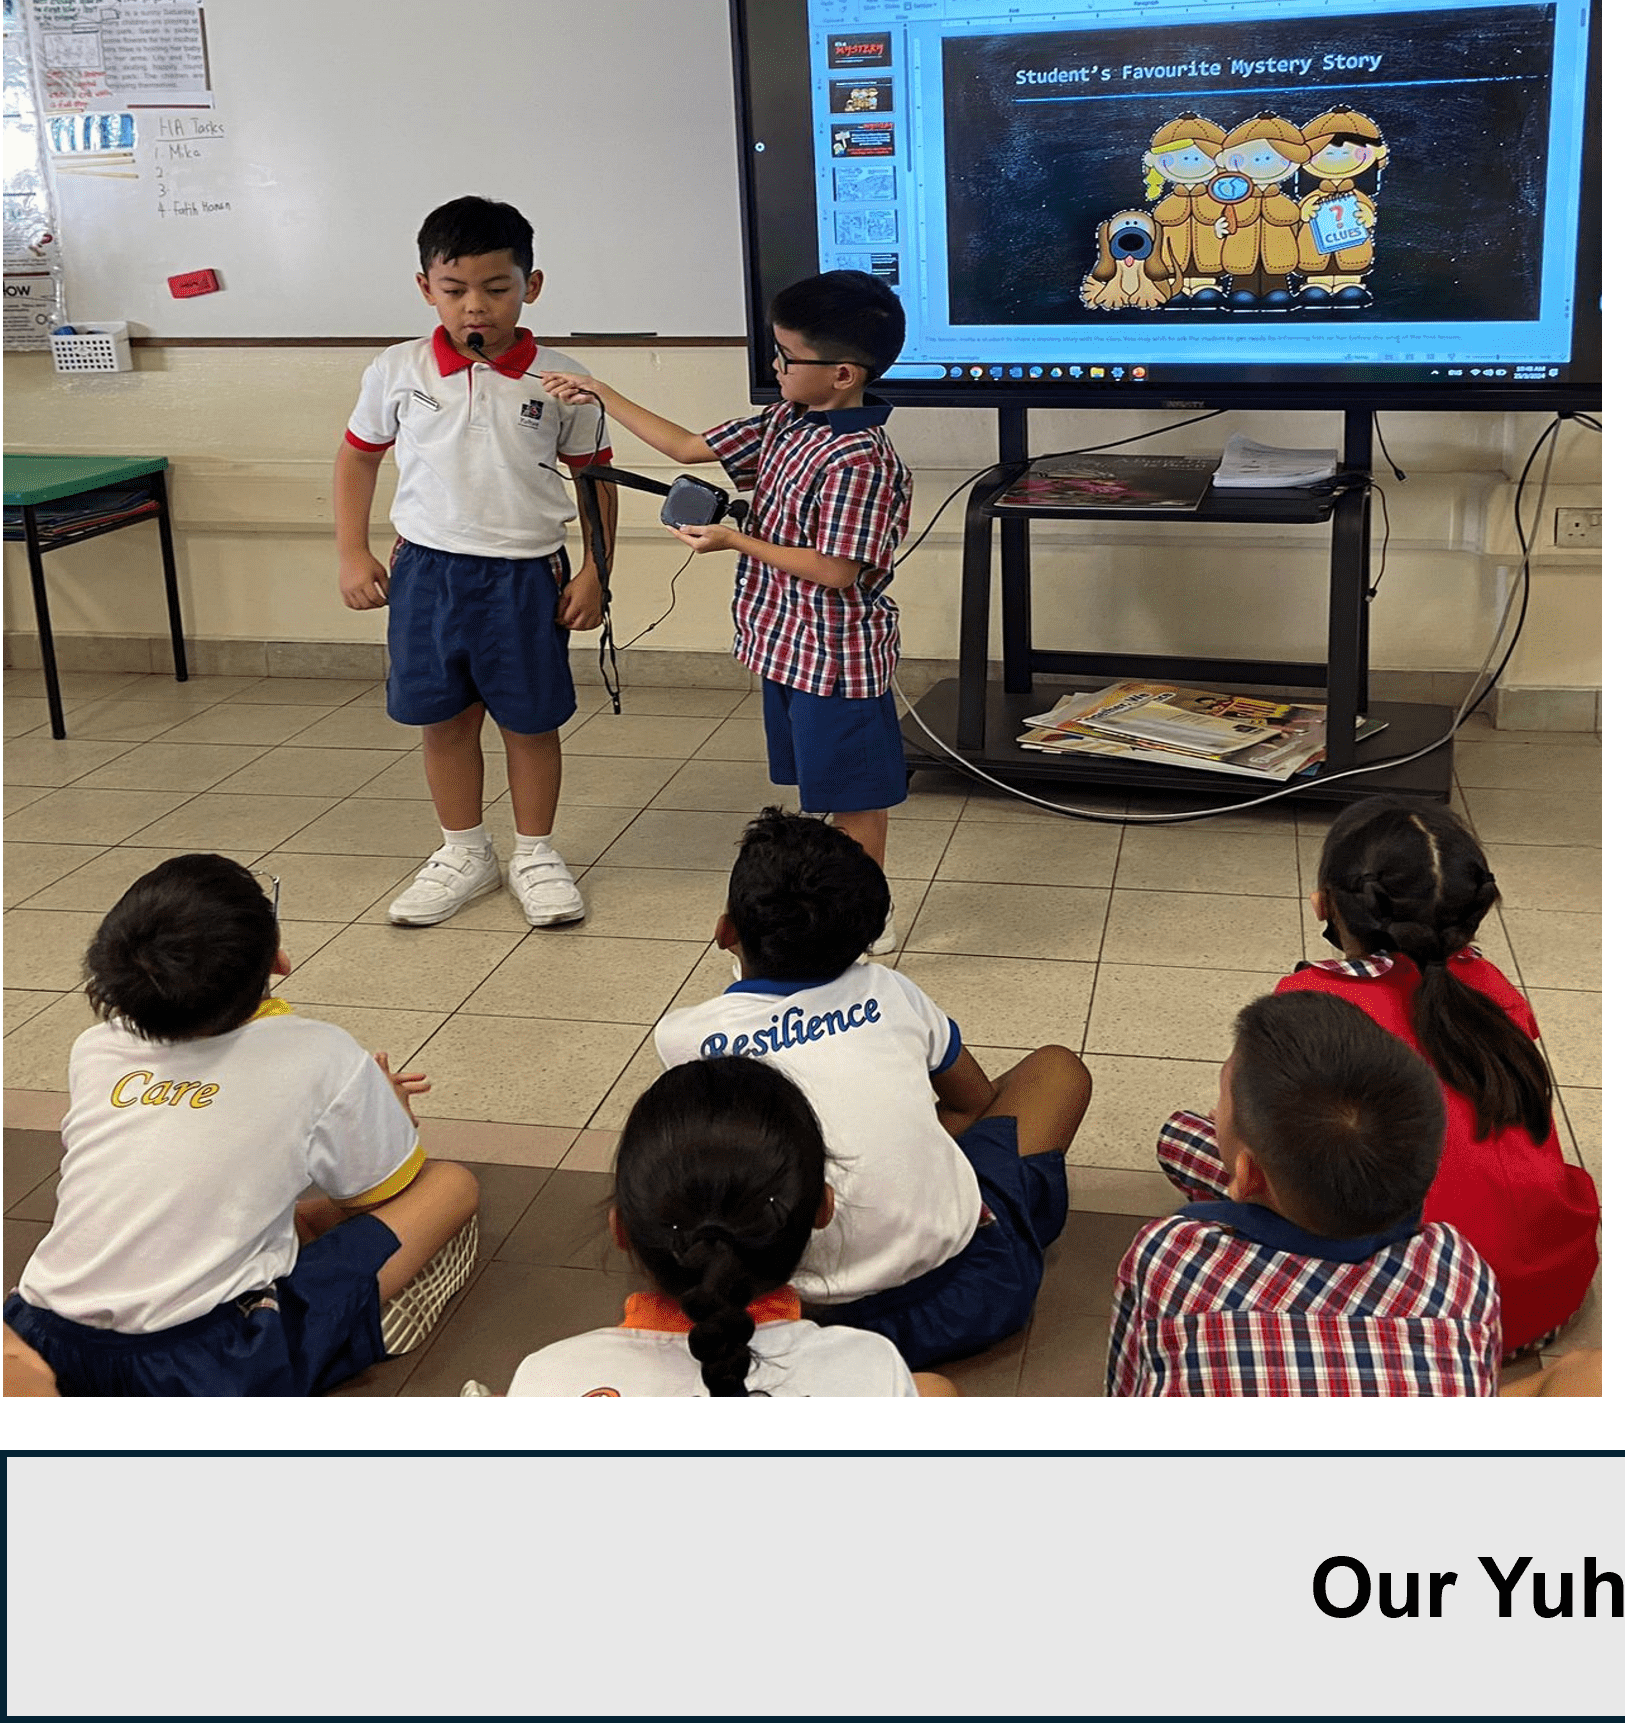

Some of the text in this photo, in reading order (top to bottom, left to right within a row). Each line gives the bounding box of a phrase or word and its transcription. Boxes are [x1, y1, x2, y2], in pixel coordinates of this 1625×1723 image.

[1121, 59, 1222, 80] Favourite
[1230, 57, 1313, 78] Mystery
[1321, 53, 1383, 72] Story
[1325, 227, 1363, 243] CLUES
[700, 998, 882, 1058] Resilience
[110, 1069, 221, 1109] Care
